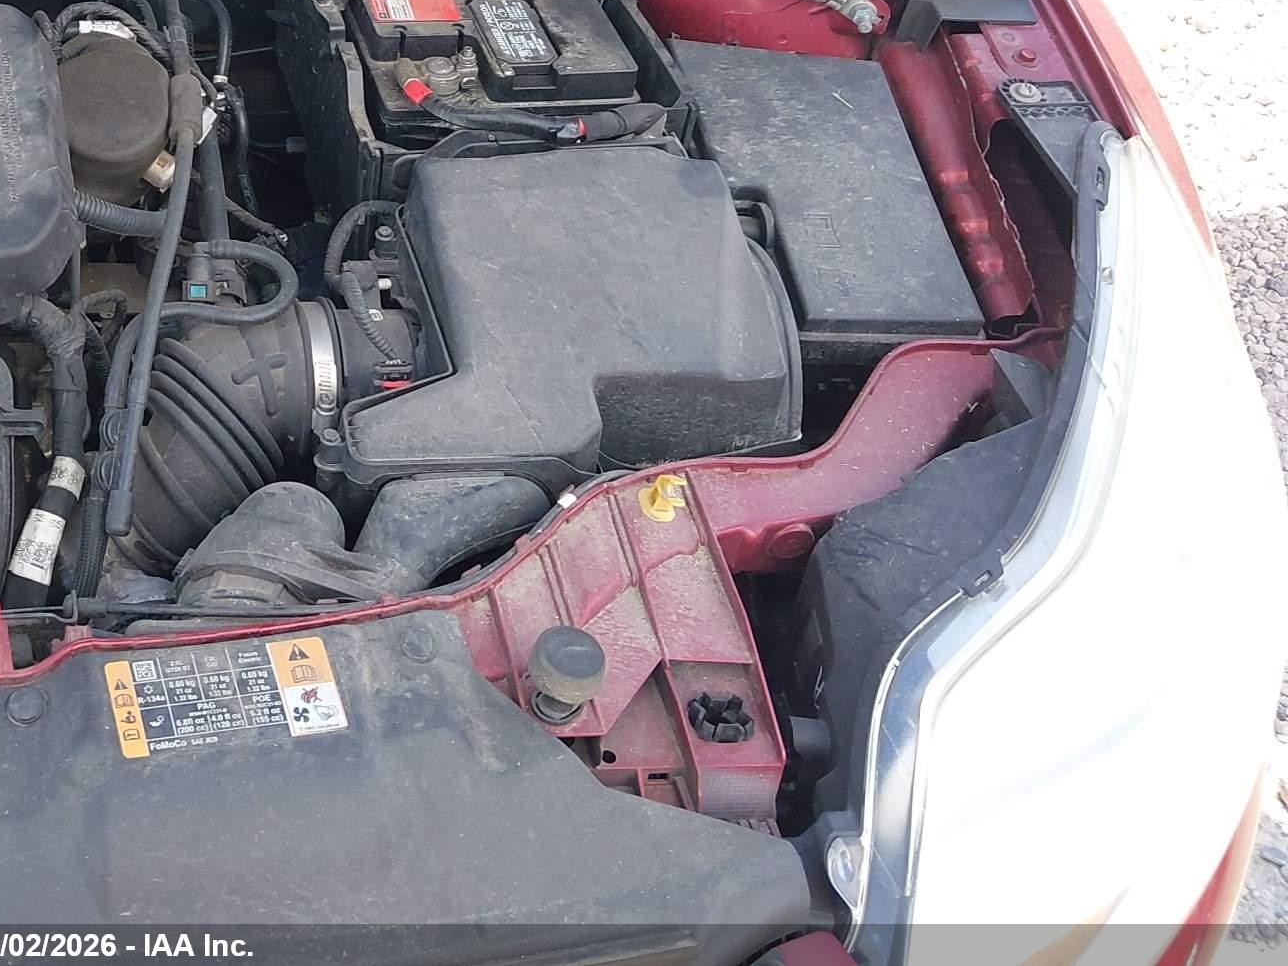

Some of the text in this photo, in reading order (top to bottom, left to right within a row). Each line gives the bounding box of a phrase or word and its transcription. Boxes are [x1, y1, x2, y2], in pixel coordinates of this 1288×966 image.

[258, 670, 268, 678] kg
[220, 675, 230, 683] kg
[186, 680, 196, 688] kg
[138, 694, 166, 704] R-134a
[252, 694, 272, 702] POE
[197, 702, 216, 710] PAG
[253, 714, 284, 725] (155 cc)
[196, 724, 209, 732] cc)
[213, 722, 231, 730] (120
[150, 739, 187, 750] FoMoCo
